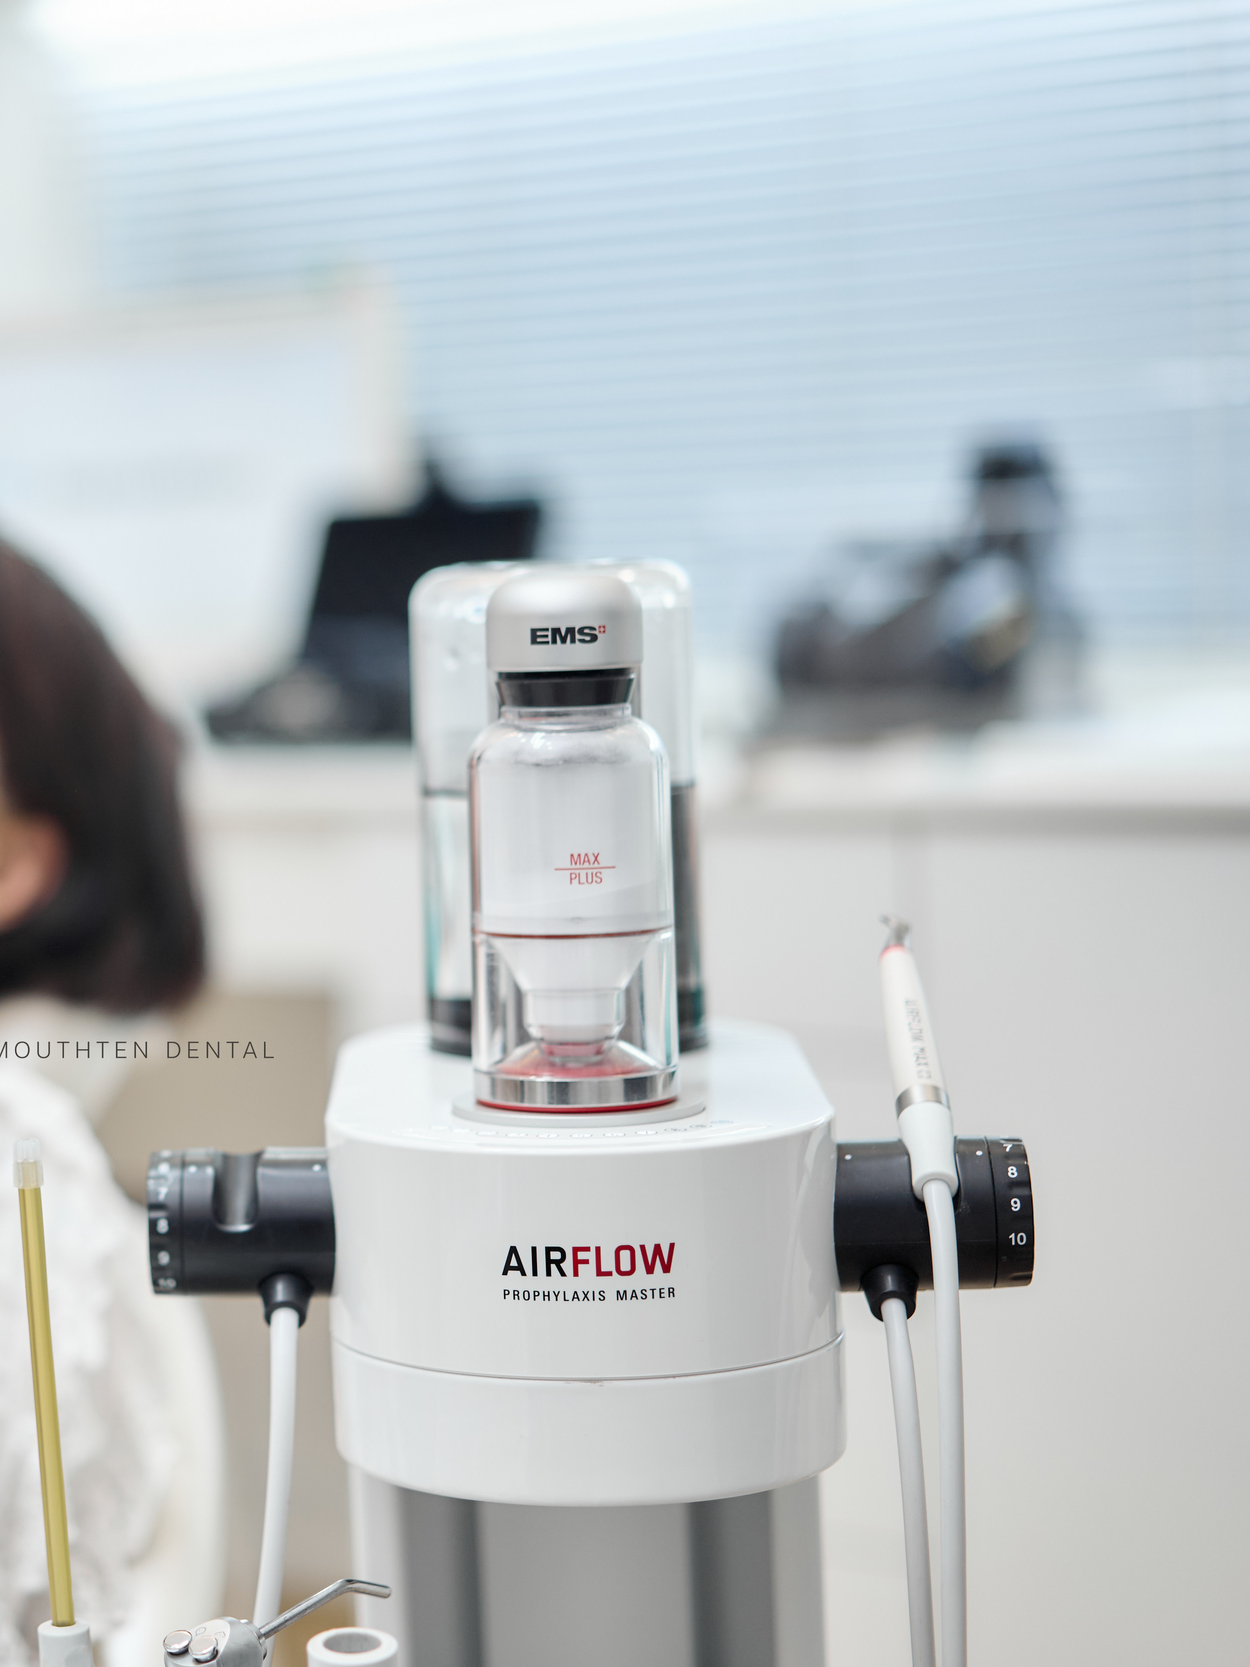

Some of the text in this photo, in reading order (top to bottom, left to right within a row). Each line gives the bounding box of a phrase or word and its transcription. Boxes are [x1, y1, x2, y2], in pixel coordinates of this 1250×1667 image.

[530, 625, 599, 646] EMS
[569, 852, 601, 867] MAX
[569, 871, 603, 886] PLUS
[1007, 1166, 1018, 1178] 8
[1010, 1197, 1021, 1212] 9
[1008, 1232, 1027, 1246] 10
[502, 1242, 676, 1278] AIRFLOW
[503, 1287, 676, 1302] PROPHYLAXIS MASTER
